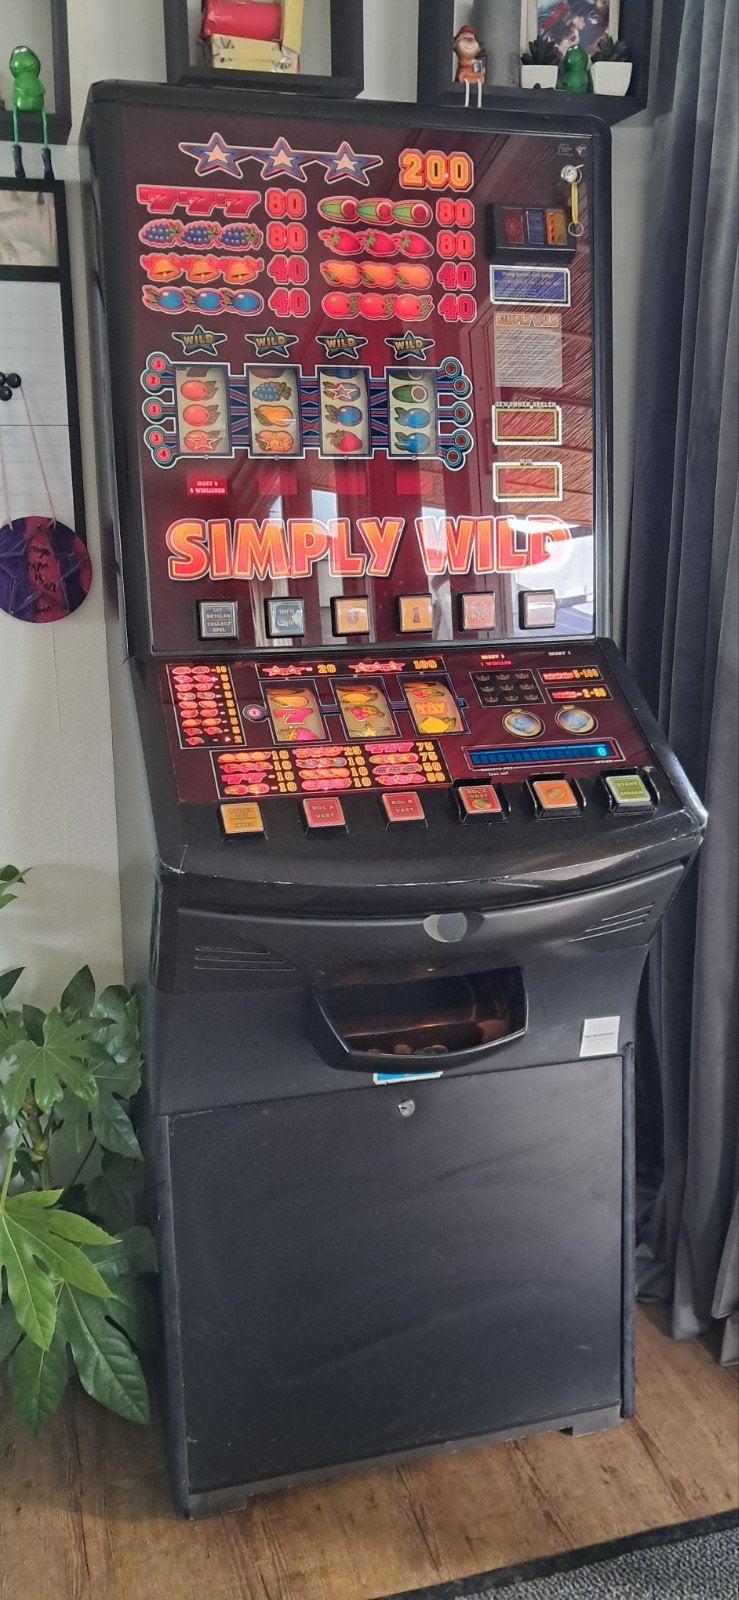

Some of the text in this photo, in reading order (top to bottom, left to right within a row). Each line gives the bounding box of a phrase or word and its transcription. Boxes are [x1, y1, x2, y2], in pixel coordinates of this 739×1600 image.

[399, 148, 474, 192] 200
[265, 187, 307, 219] 80
[435, 197, 475, 228] 80
[266, 221, 308, 252] 80
[436, 230, 476, 260] 80
[267, 254, 309, 285] 40
[437, 262, 477, 291] 40
[268, 287, 310, 317] 40
[437, 293, 477, 322] 40
[183, 332, 215, 346] WILD
[256, 335, 287, 347] WILD
[326, 337, 356, 349] WILD
[394, 338, 424, 350] WILD
[166, 515, 572, 580] SIMPLY WILD
[413, 607, 421, 624] 1
[317, 663, 337, 674] 20
[413, 659, 438, 670] 100
[416, 741, 435, 751] 75
[271, 750, 289, 760] 10
[347, 756, 366, 766] 10
[419, 751, 438, 762] 75
[273, 760, 292, 770] 10
[350, 766, 369, 777] 10
[353, 776, 372, 788] 10
